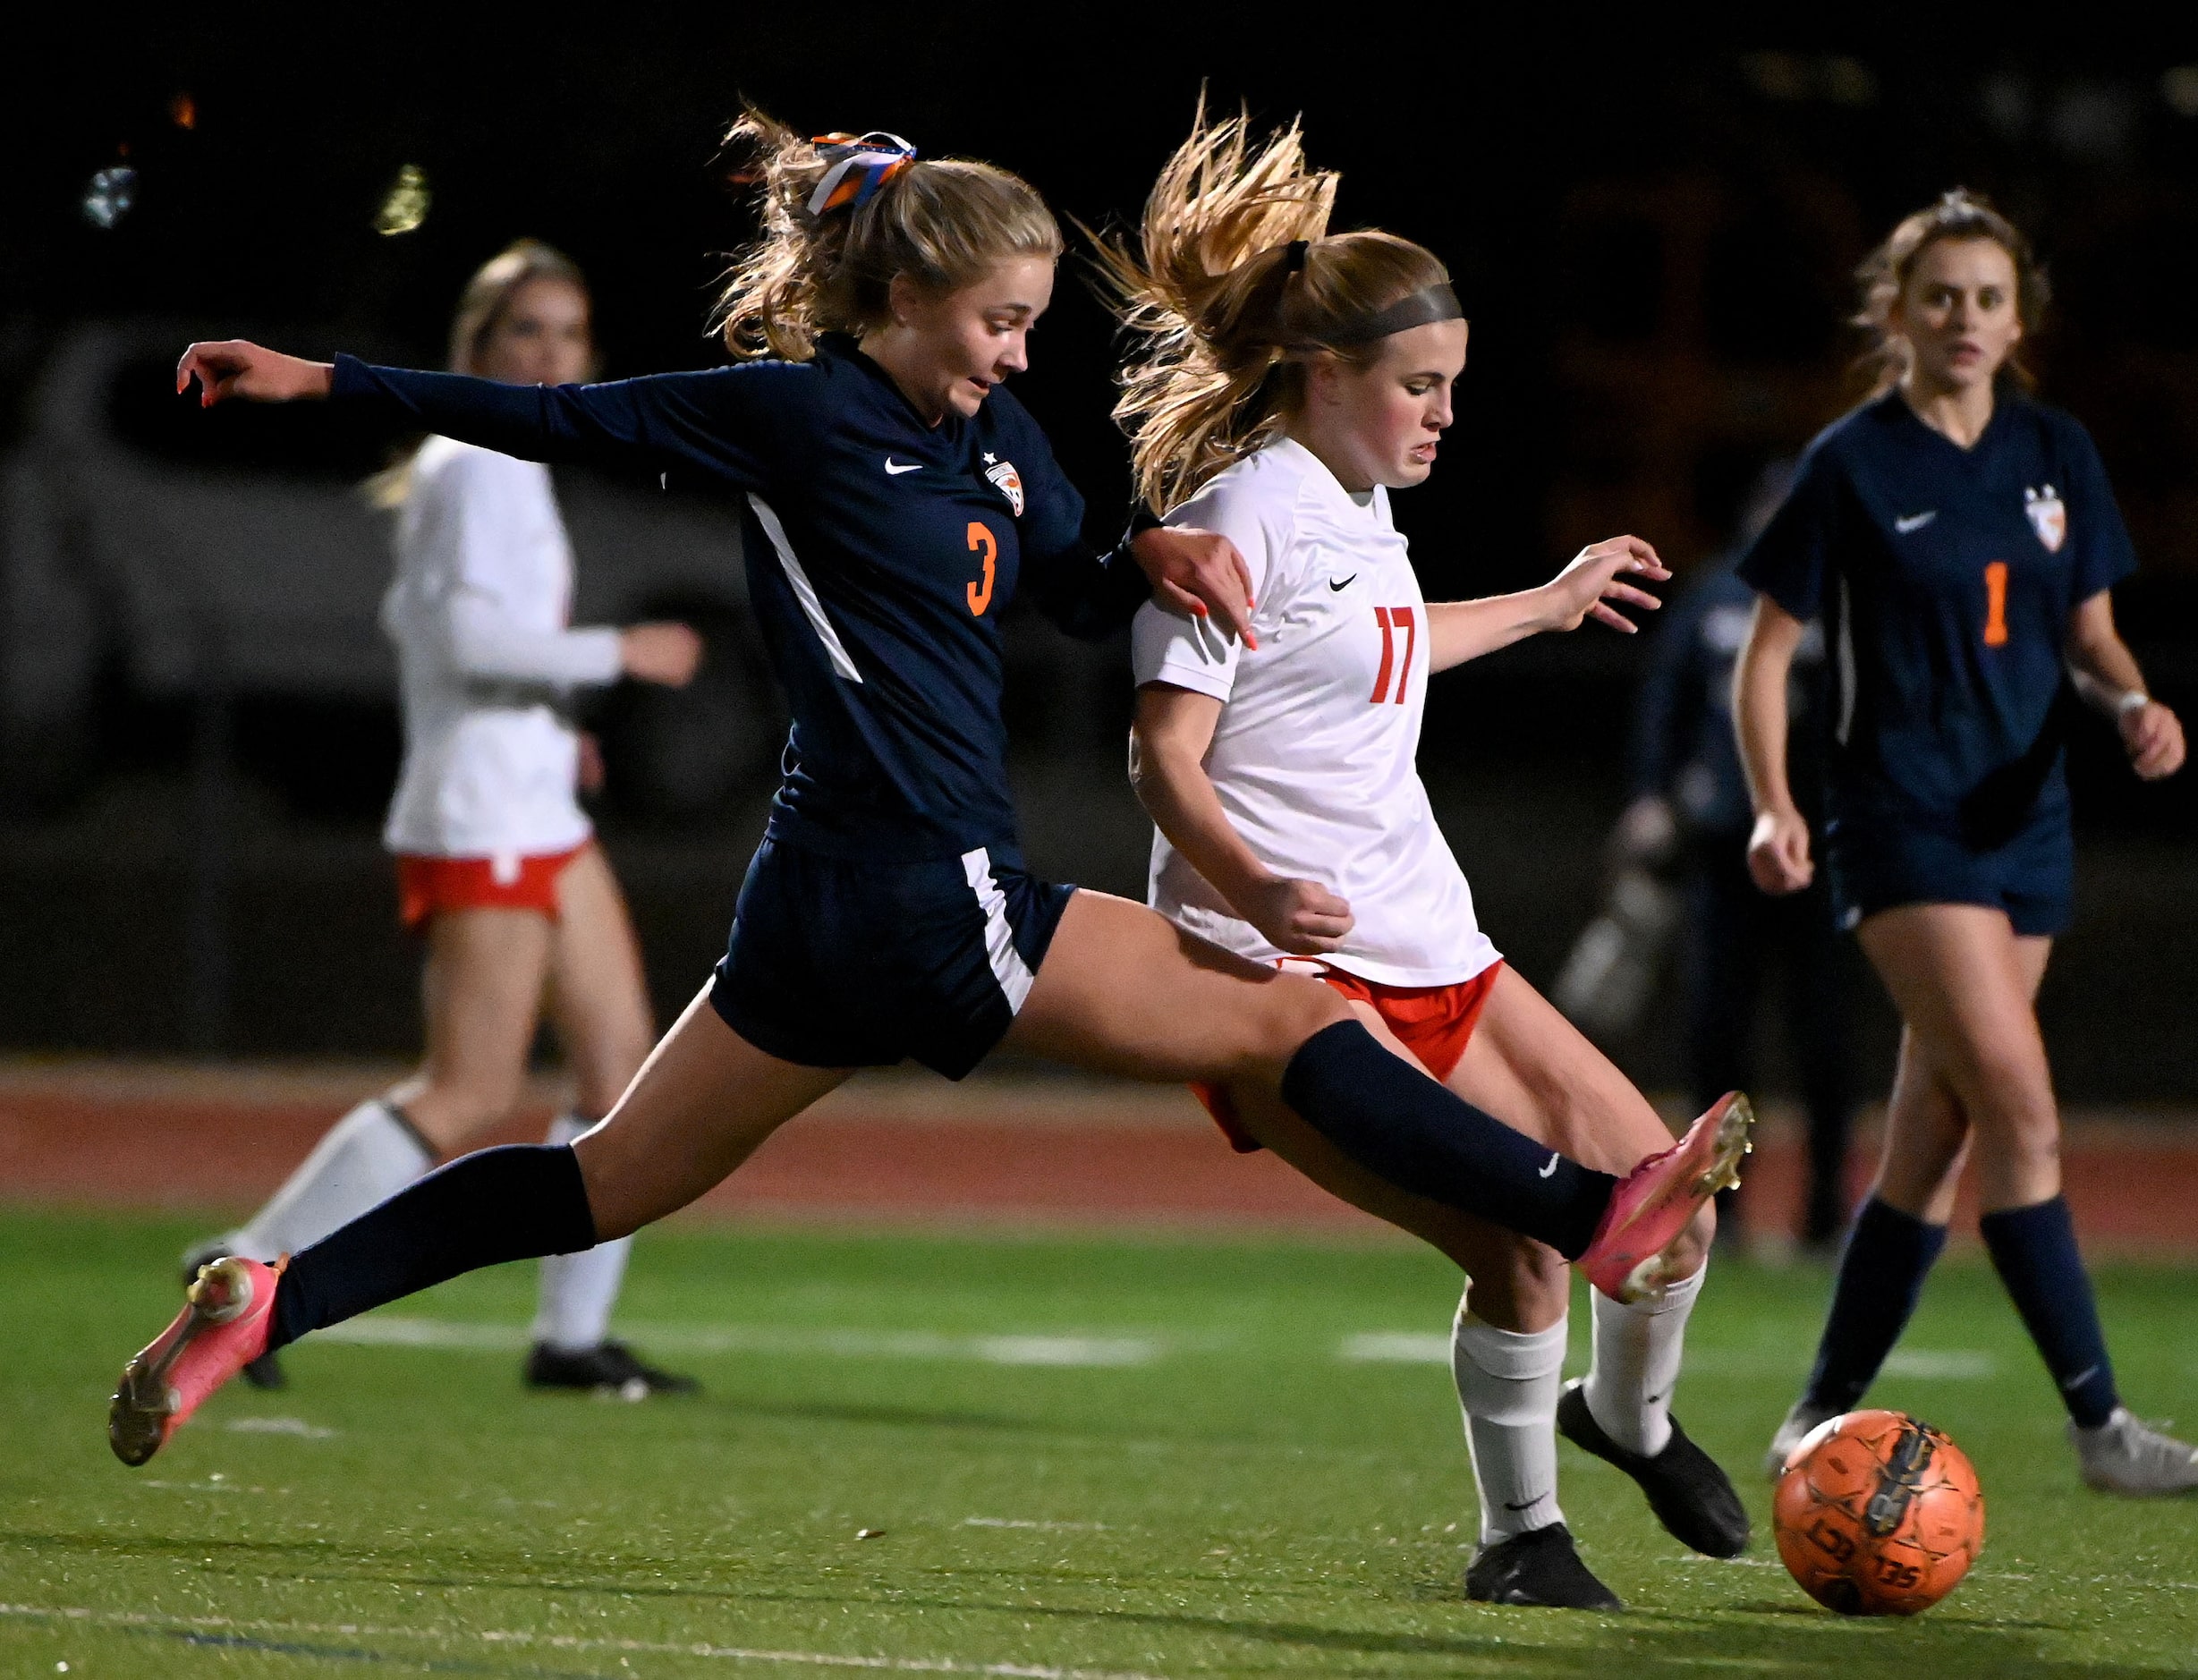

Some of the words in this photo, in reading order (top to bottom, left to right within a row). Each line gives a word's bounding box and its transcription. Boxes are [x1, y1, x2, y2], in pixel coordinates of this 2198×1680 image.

[967, 522, 997, 616] 3
[1983, 561, 2009, 647] 1
[1370, 607, 1415, 704] 17
